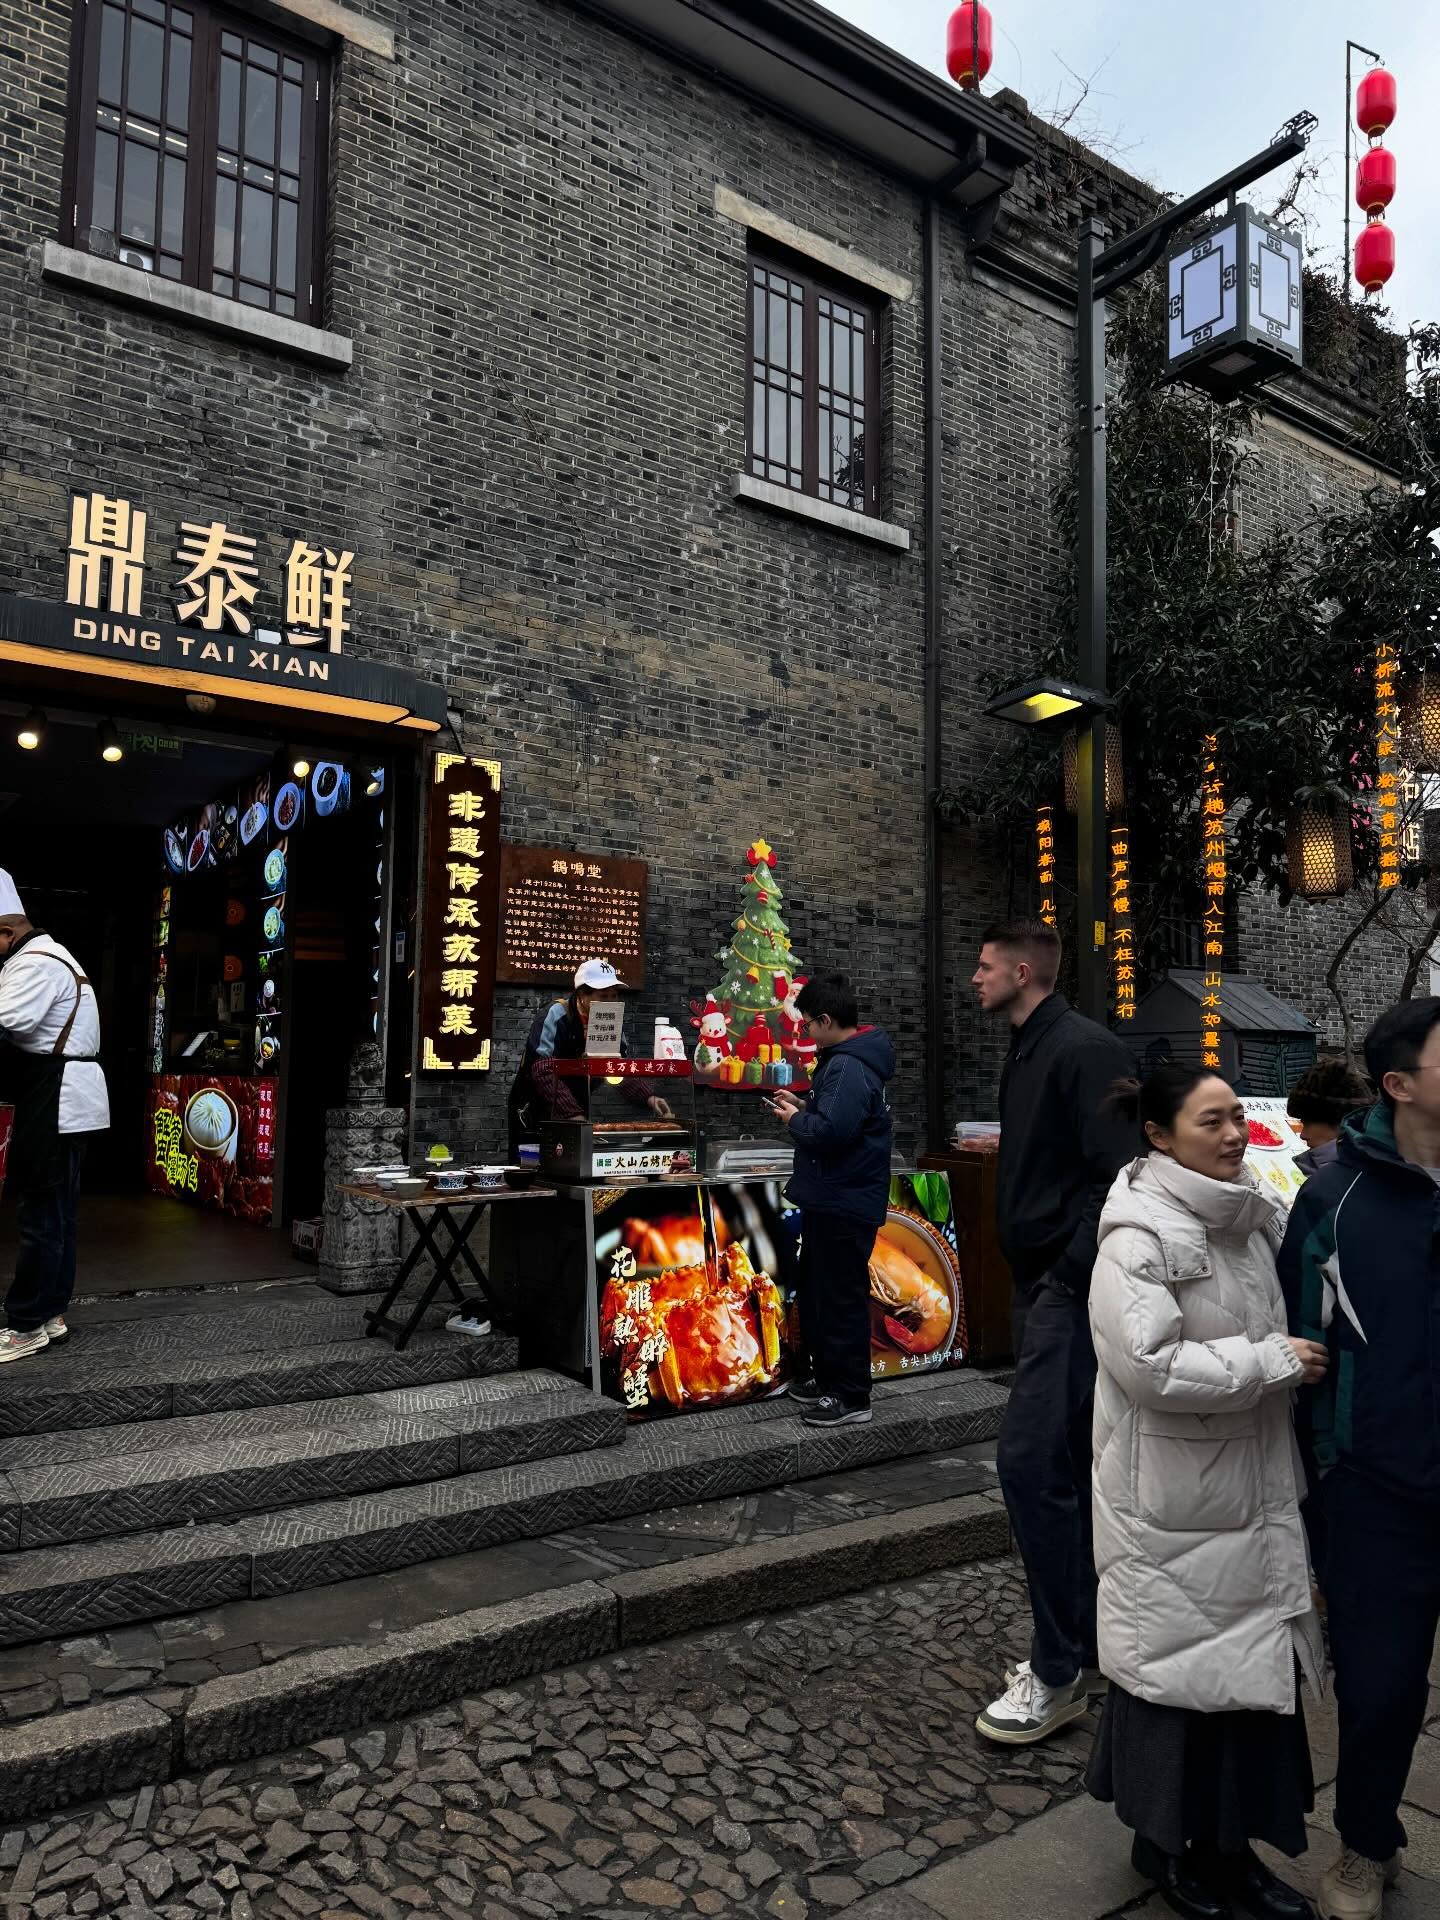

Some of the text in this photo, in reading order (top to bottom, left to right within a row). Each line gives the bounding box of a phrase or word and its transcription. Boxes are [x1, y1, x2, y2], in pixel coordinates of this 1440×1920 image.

[64, 492, 356, 655] 鼎泰鲜
[73, 617, 330, 681] DING TAI XIAN
[1375, 643, 1400, 889] 小桥流水人家 粉墙青瓦摇船
[439, 790, 486, 1036] 非遗传承苏帮菜
[552, 859, 602, 879] 鹤鸣堂
[1110, 826, 1136, 1019] 一曲声声慢 不枉苏州行
[605, 1061, 678, 1074] 惠万家 进万家
[1202, 972, 1223, 1068] 山水如墨染
[615, 1155, 672, 1169] 火山石烤肠
[610, 1245, 670, 1410] 花雕熟醉蟹
[900, 1347, 963, 1369] 舌尖上的中国
